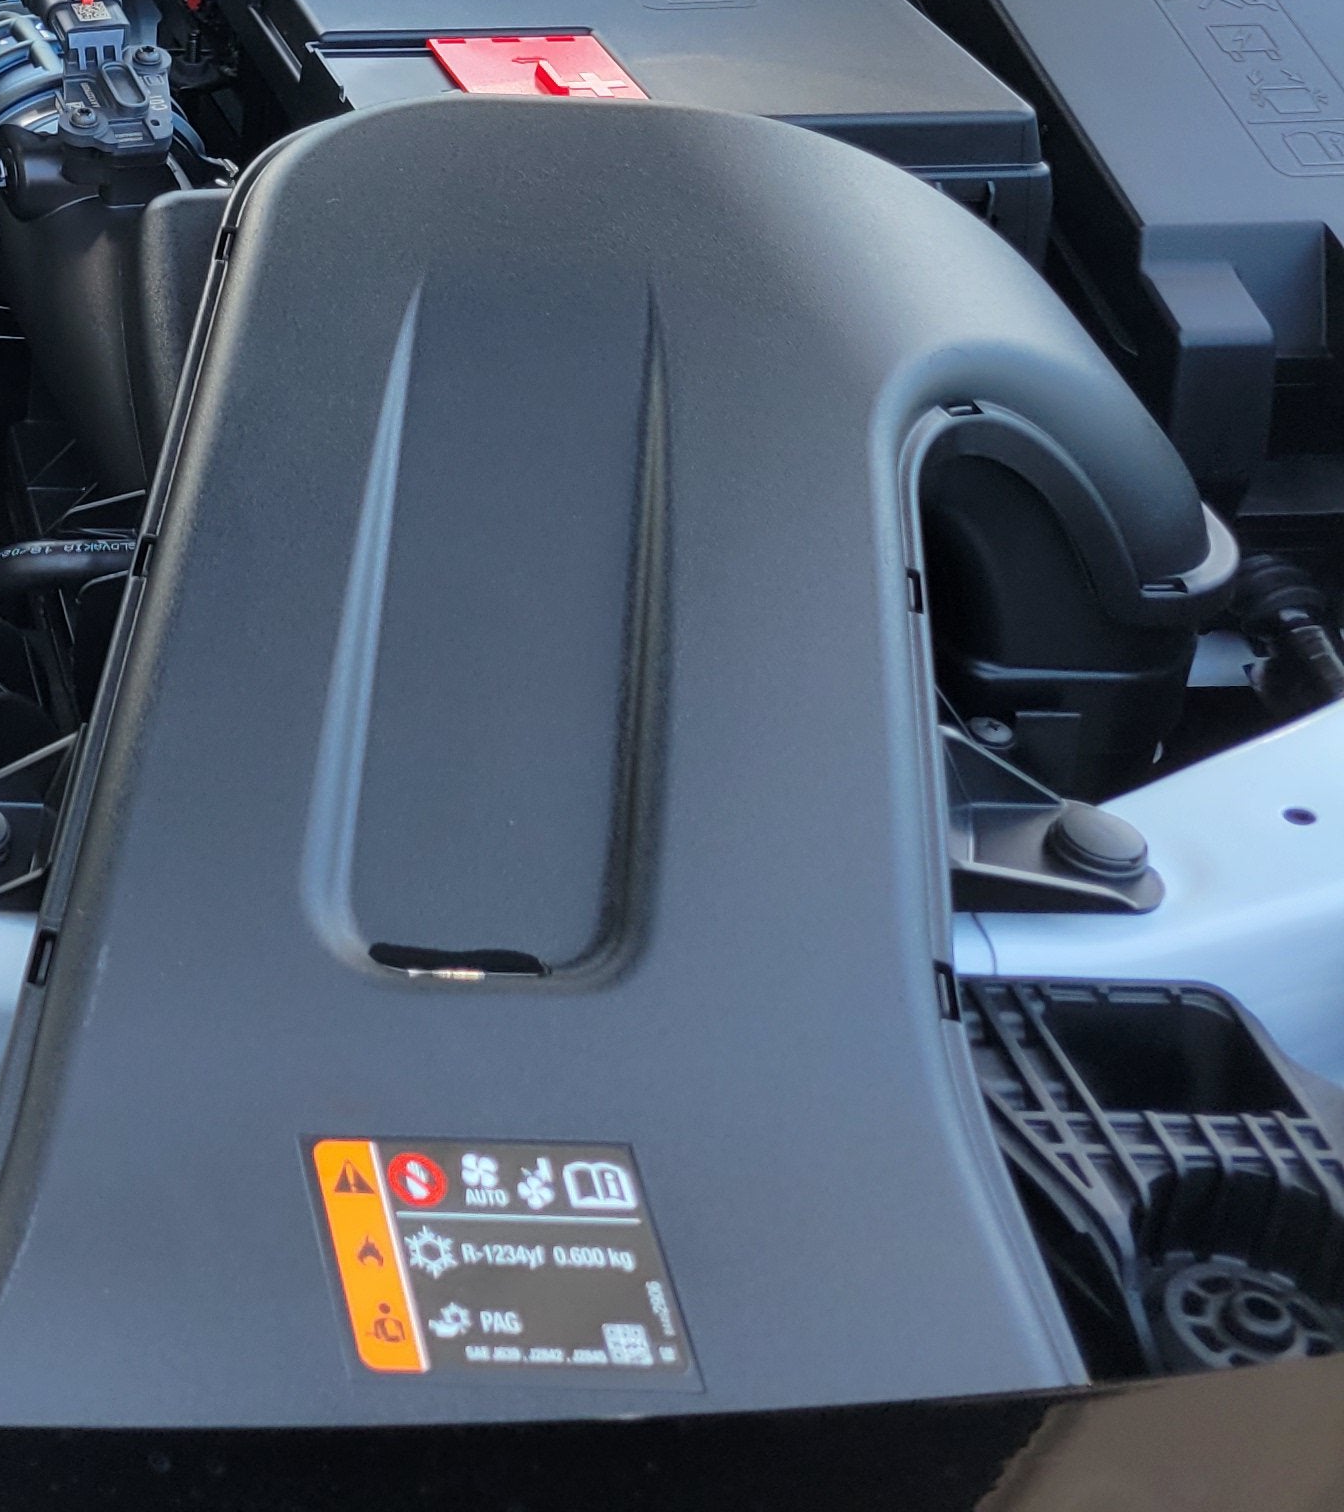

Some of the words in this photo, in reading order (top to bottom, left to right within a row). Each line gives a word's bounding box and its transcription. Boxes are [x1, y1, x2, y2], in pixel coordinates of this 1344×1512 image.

[465, 1188, 510, 1207] AUTO
[460, 1242, 545, 1270] R-1234yf
[553, 1246, 605, 1268] 0.600
[605, 1248, 636, 1273] kg
[479, 1310, 523, 1336] PAG
